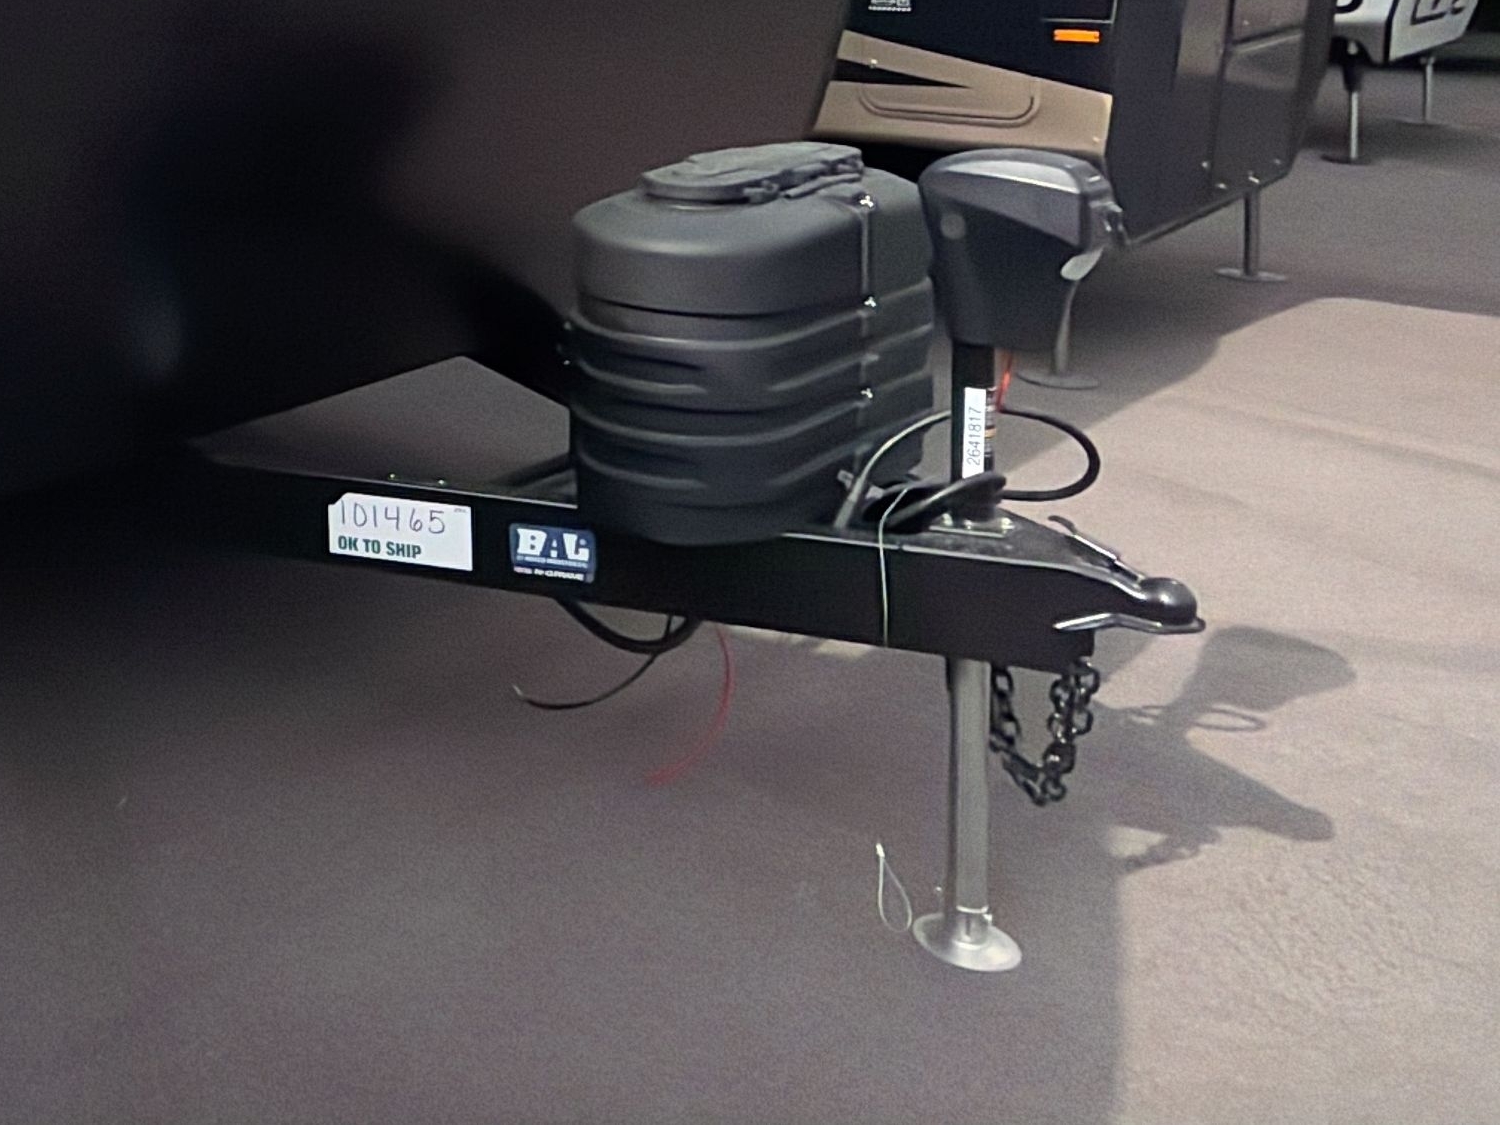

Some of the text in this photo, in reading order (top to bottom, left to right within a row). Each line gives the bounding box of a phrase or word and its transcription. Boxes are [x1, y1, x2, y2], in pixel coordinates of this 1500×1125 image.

[966, 406, 983, 466] 2641817
[339, 502, 446, 535] 101465
[337, 535, 422, 559] OK TO SHIP
